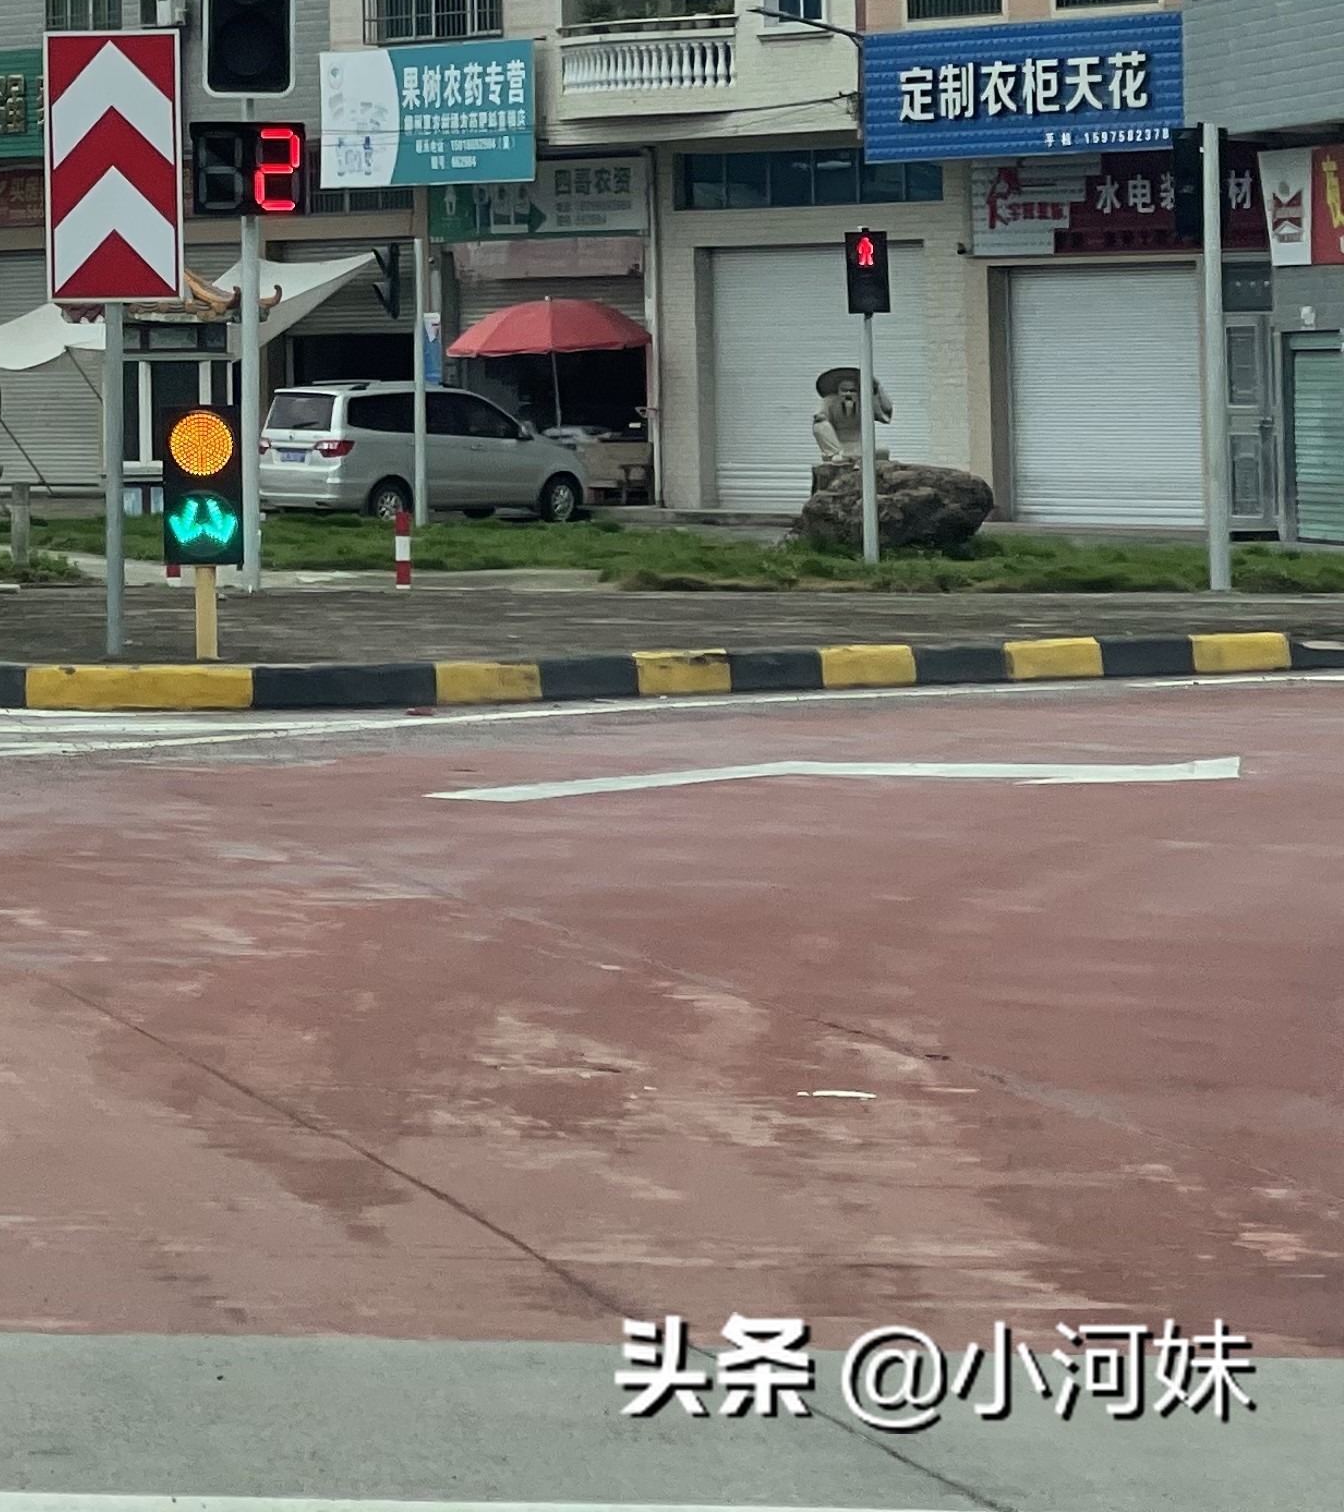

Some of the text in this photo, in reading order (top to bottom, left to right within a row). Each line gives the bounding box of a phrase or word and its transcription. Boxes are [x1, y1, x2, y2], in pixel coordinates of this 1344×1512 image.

[402, 59, 526, 110] 果树农药专营
[899, 50, 1148, 122] 定制衣柜天花
[254, 128, 300, 211] 2
